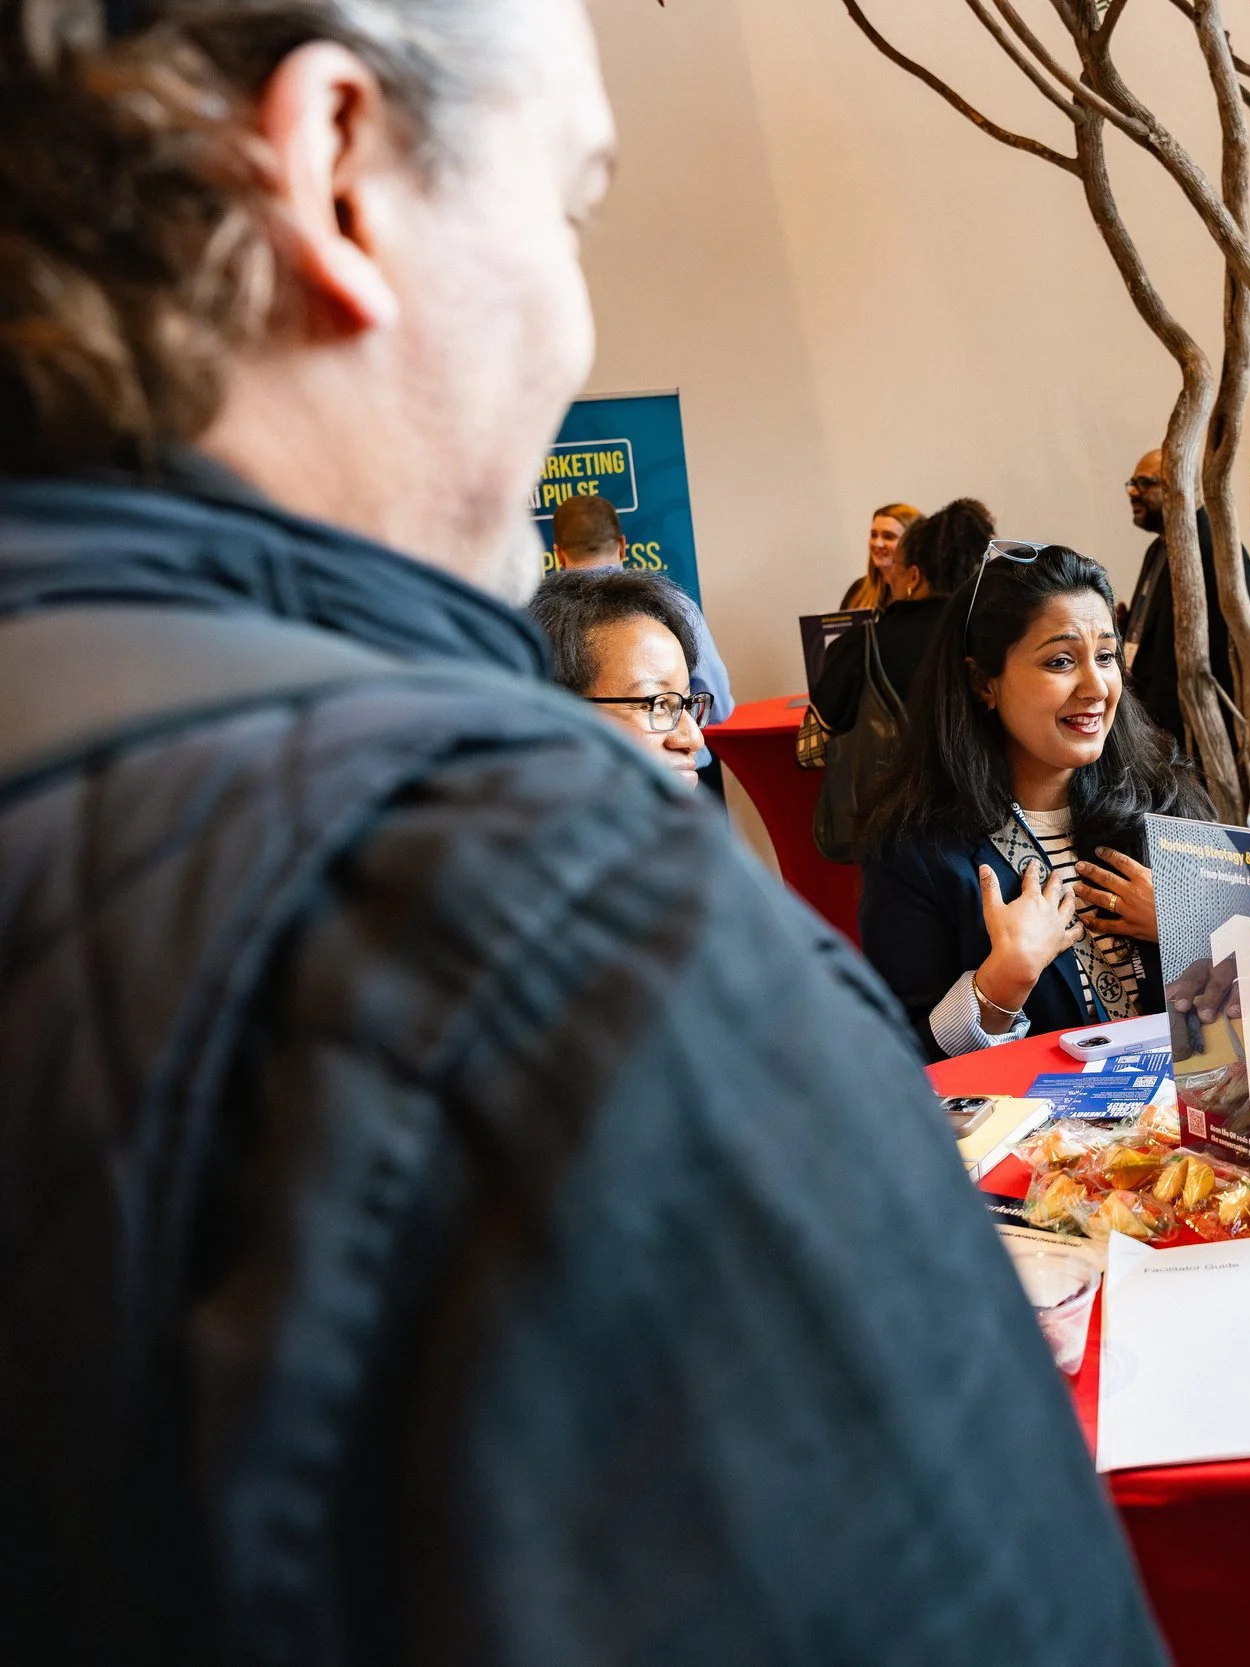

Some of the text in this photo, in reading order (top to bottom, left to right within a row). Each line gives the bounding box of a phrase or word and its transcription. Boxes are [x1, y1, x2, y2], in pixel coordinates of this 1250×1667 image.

[537, 450, 625, 480] ARKETING
[1204, 844, 1244, 866] Strategy
[1217, 869, 1247, 886] Insights
